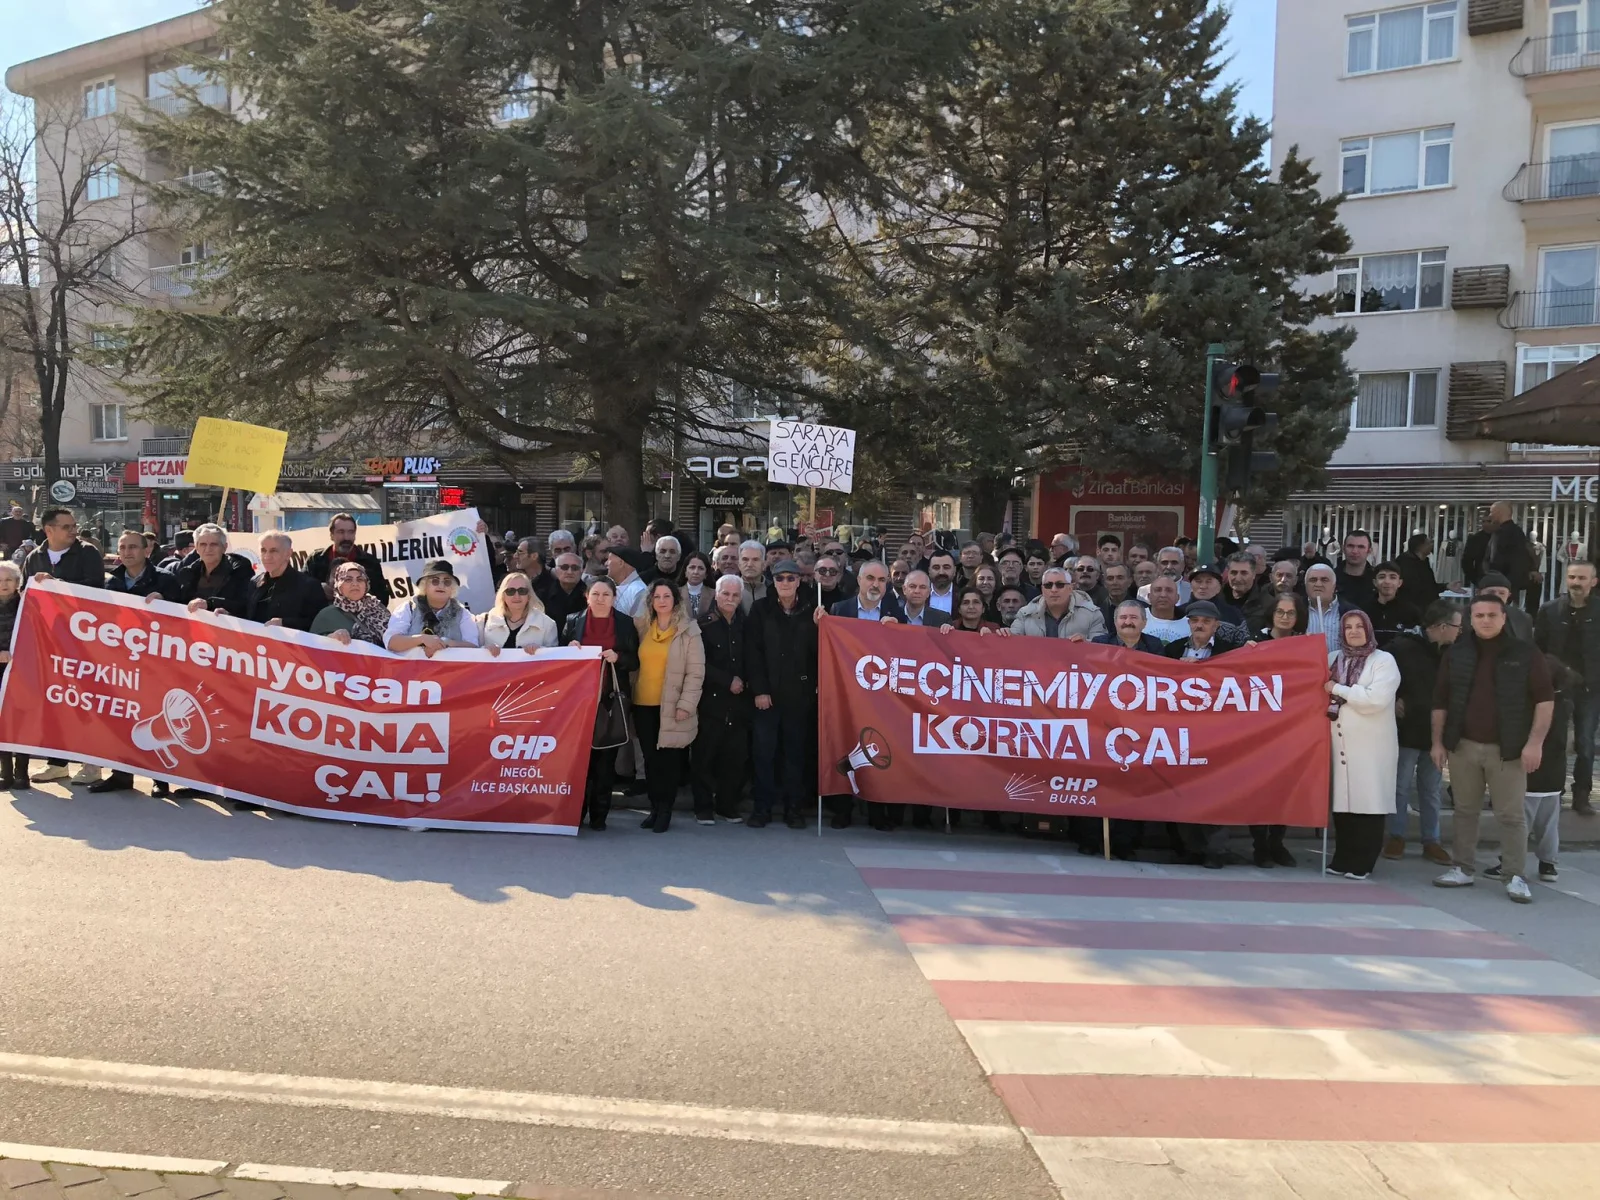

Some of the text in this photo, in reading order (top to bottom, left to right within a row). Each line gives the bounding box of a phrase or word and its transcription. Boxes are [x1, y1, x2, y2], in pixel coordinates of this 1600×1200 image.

[776, 422, 849, 447] SARAYA
[792, 440, 835, 457] VAR
[140, 460, 188, 476] ECZAN
[403, 457, 442, 475] PLUS+
[789, 467, 843, 490] YOK
[1088, 480, 1185, 495] Ziraat Bankası
[705, 495, 745, 506] exclusive
[69, 611, 442, 705] Geçinemiyorsan
[50, 654, 139, 691] TEPKİNİ
[855, 655, 1283, 712] GEÇİNEMİYORSAN
[46, 684, 141, 721] GÖSTER
[255, 698, 446, 754] KORNA
[489, 735, 557, 760] CHP
[918, 714, 1208, 772] KORNA ÇAL
[314, 764, 442, 803] ÇAL!
[500, 765, 544, 779] İNEGÖL
[470, 779, 571, 796] İLÇE BAŞKANLIĞI
[1049, 776, 1098, 792] CHP
[1049, 793, 1097, 806] BURSA
